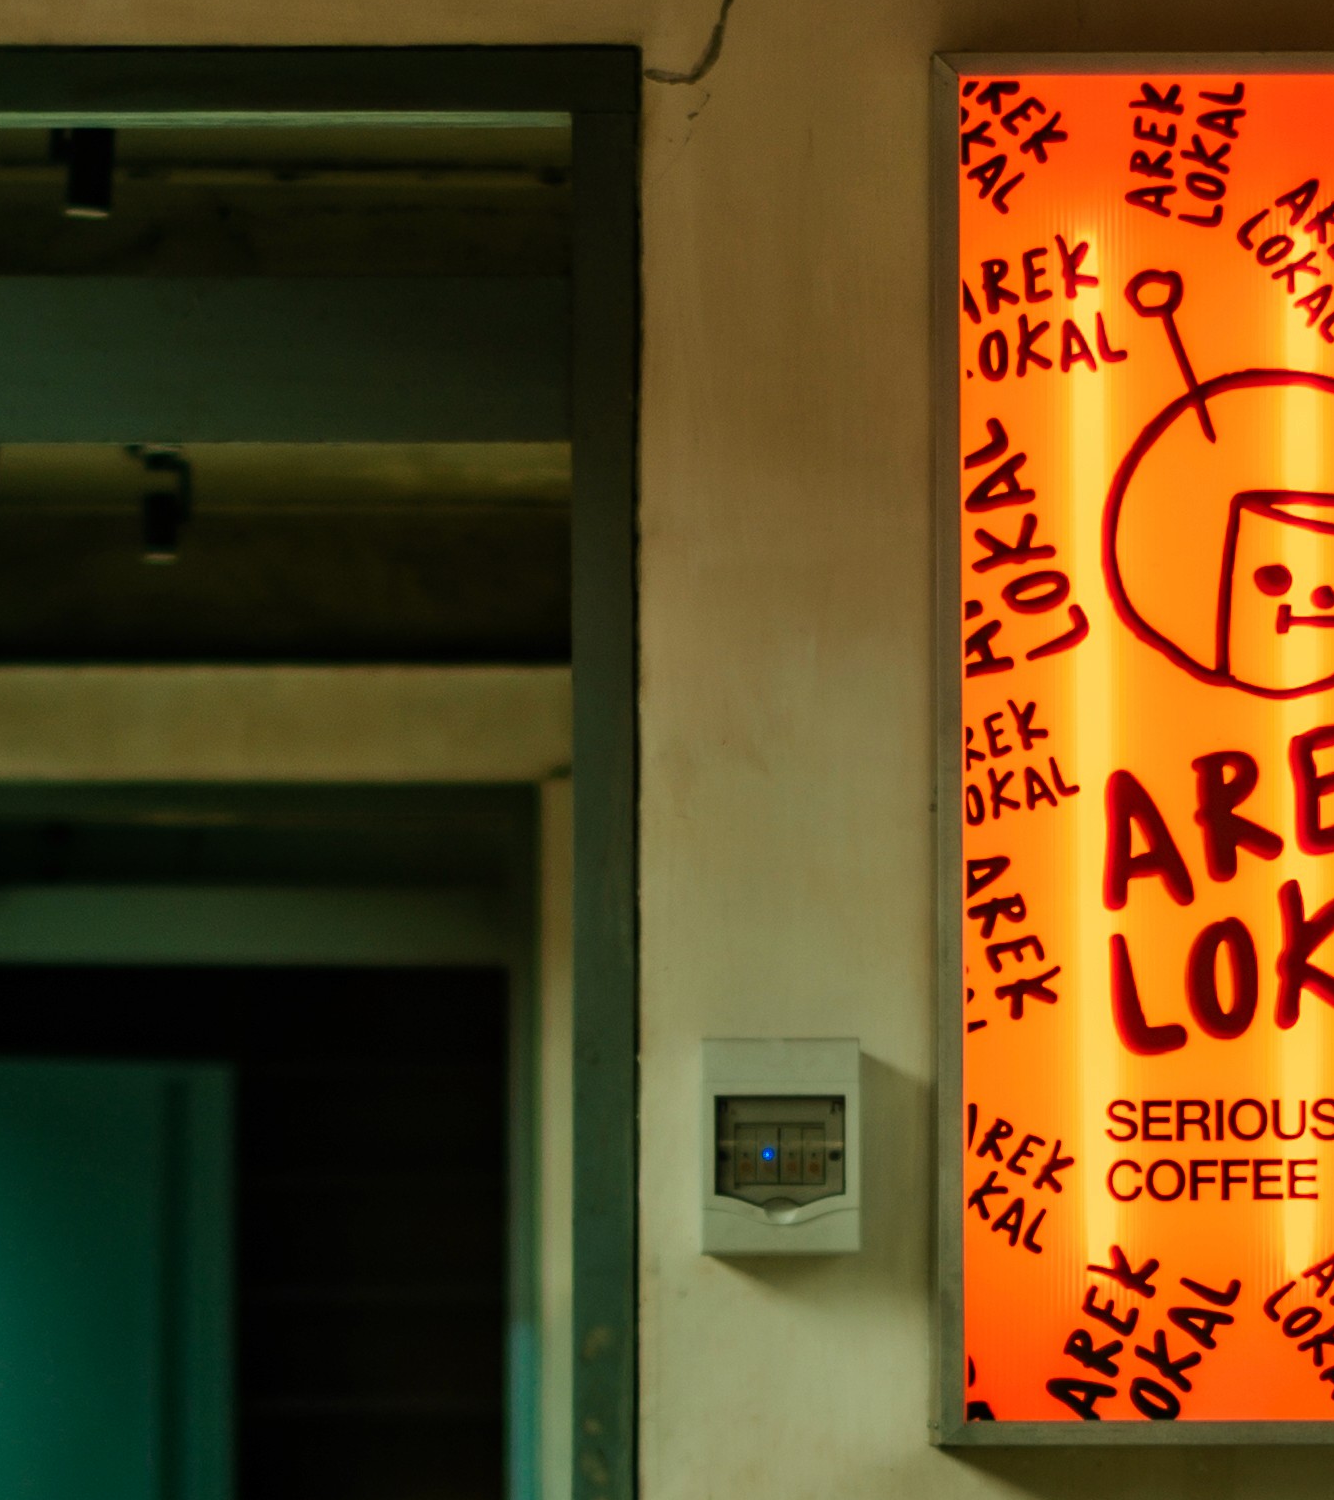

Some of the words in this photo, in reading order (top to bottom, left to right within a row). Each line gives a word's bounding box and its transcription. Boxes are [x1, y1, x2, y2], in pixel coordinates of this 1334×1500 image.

[1124, 82, 1184, 218] AREK
[1177, 82, 1247, 228] LOKAL
[964, 416, 1091, 662] LOKAL
[967, 855, 1062, 1021] AREK
[1106, 1158, 1319, 1202] COFFEE
[1045, 1244, 1160, 1421] AREK
